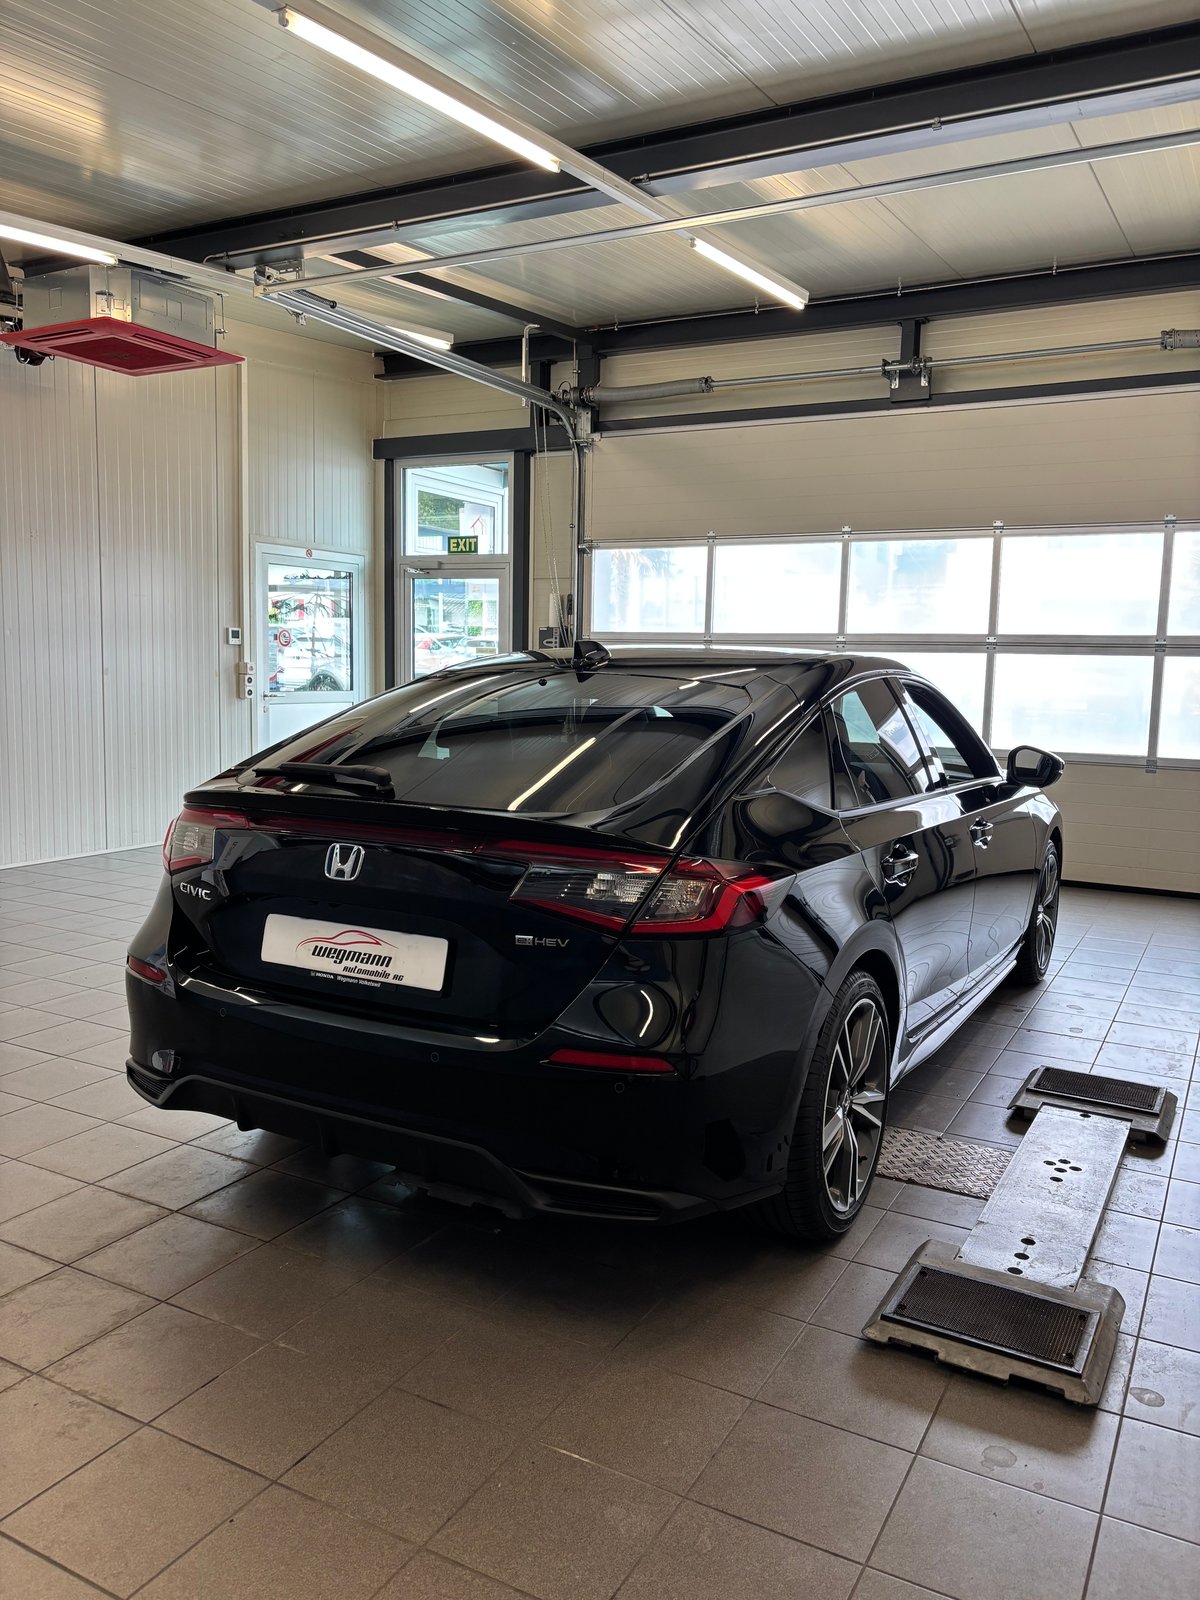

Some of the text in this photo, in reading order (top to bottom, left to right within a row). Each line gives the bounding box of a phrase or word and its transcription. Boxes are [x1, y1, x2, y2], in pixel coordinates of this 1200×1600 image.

[450, 538, 476, 552] EXIT
[180, 882, 211, 902] CIVIC
[312, 945, 392, 968] wegmann
[316, 972, 334, 980] HONDA
[336, 975, 359, 984] Wegmann
[393, 974, 404, 982] AG
